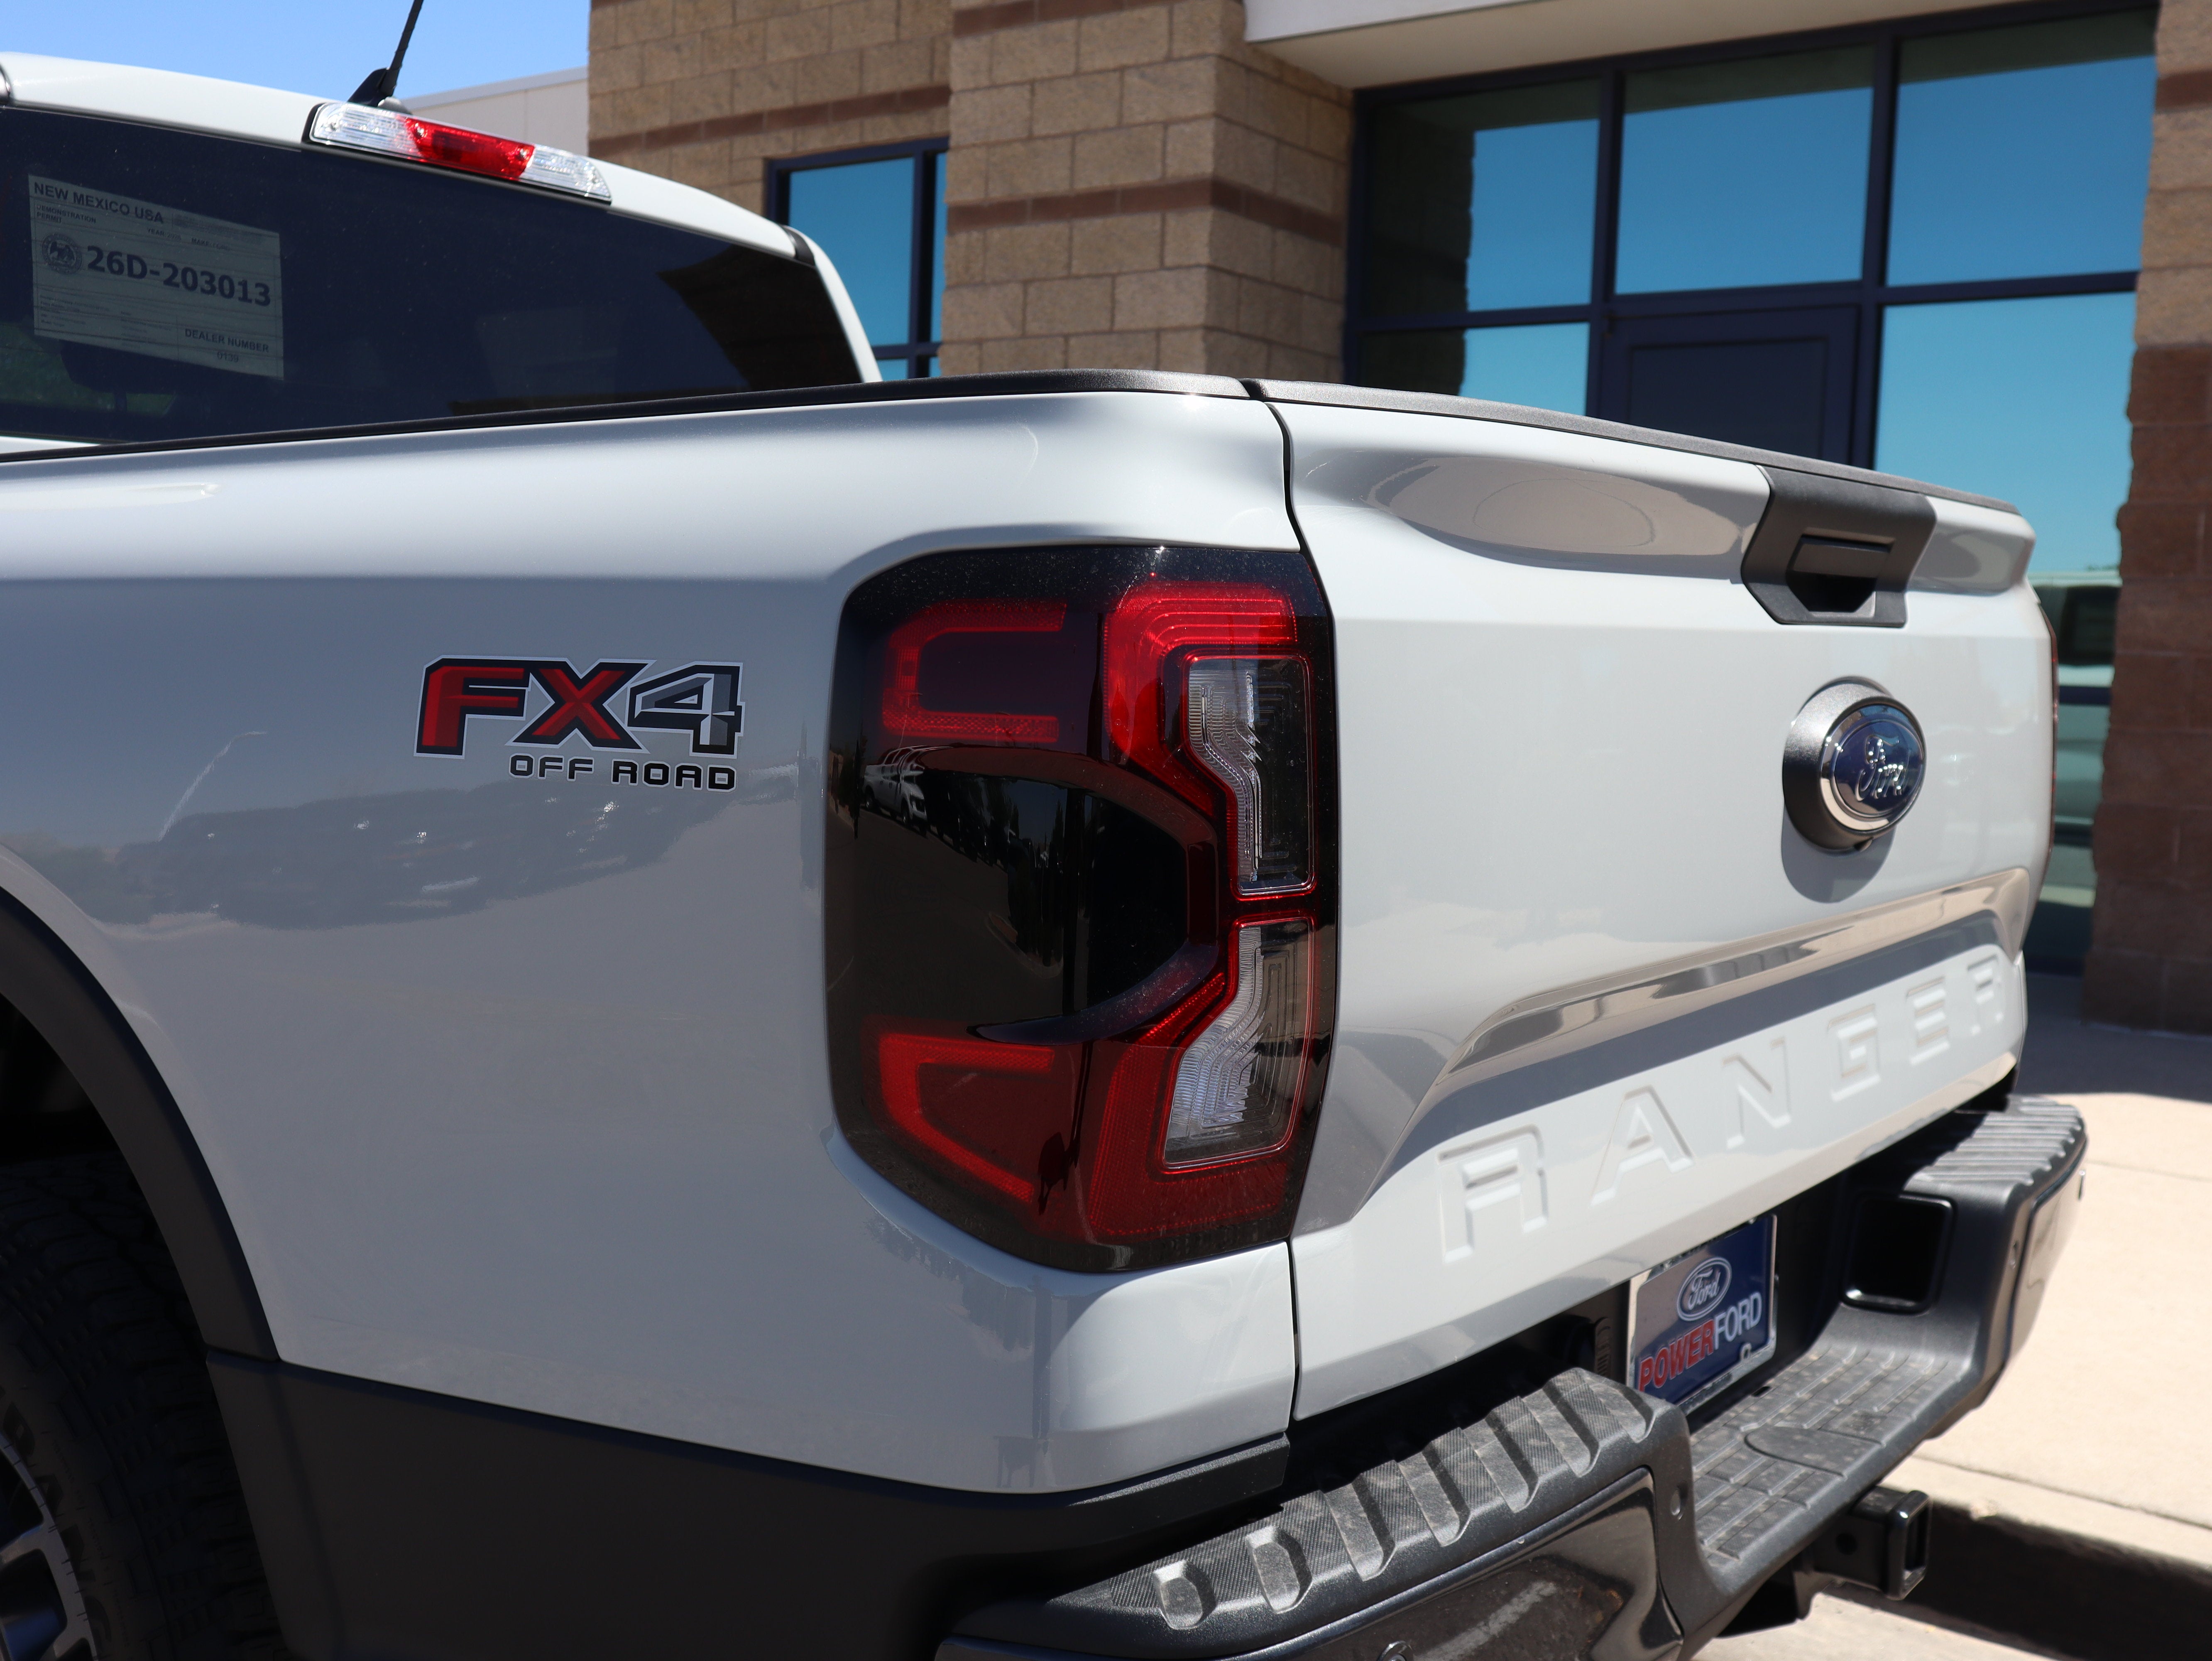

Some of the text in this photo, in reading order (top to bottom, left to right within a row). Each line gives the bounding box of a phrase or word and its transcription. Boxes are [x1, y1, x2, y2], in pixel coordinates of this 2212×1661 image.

[34, 182, 164, 223] NEW MEXICO USA
[37, 211, 62, 223] PERMIT
[86, 245, 271, 307] 26D-203013
[185, 328, 225, 345] DEALER
[227, 336, 269, 353] NUMBER
[414, 655, 745, 759] FX4
[509, 753, 737, 792] OFF ROAD
[1436, 952, 2004, 1264] RANGER
[1687, 1267, 1722, 1311] Ford
